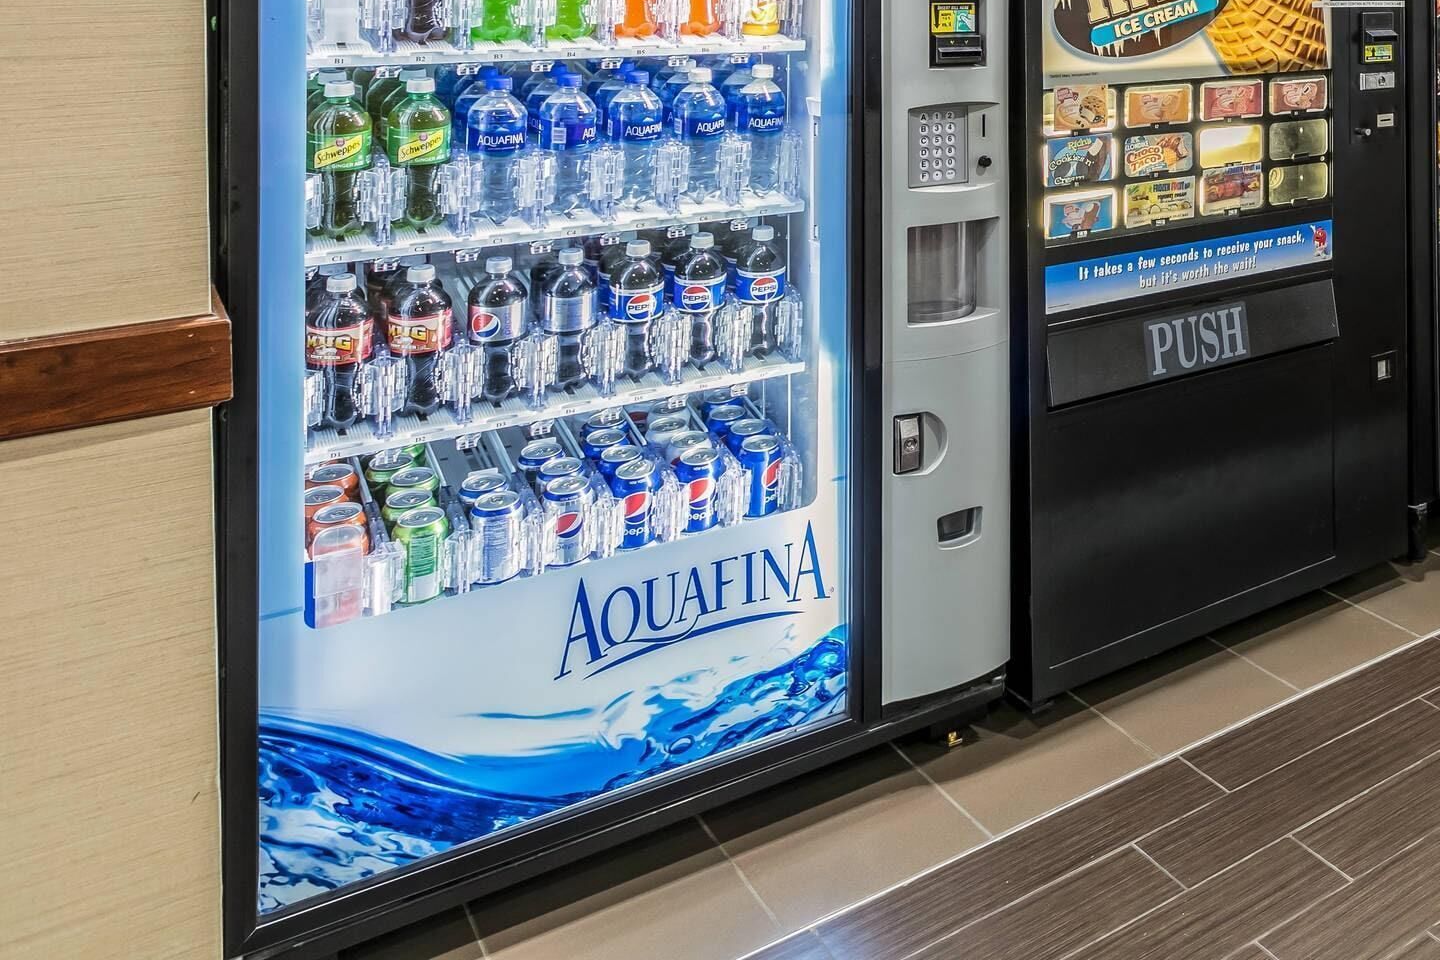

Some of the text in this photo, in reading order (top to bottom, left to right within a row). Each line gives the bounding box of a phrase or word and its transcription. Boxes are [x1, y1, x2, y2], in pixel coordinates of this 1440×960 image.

[1114, 0, 1199, 39] ICE CREAM
[400, 137, 441, 159] Schweppes
[477, 133, 524, 146] AQUAFINA
[317, 141, 361, 164] Schweppes
[1127, 147, 1160, 164] CHOCO
[1131, 156, 1157, 172] TACO
[1054, 175, 1085, 185] Cream
[1079, 230, 1305, 281] It takes a few seconds to receive your snack,
[1140, 256, 1257, 289] but it's worth the wait!
[307, 334, 351, 351] MUG
[388, 323, 427, 341] MUG
[1149, 306, 1247, 376] PUSH
[554, 519, 831, 680] AQUAFINA
